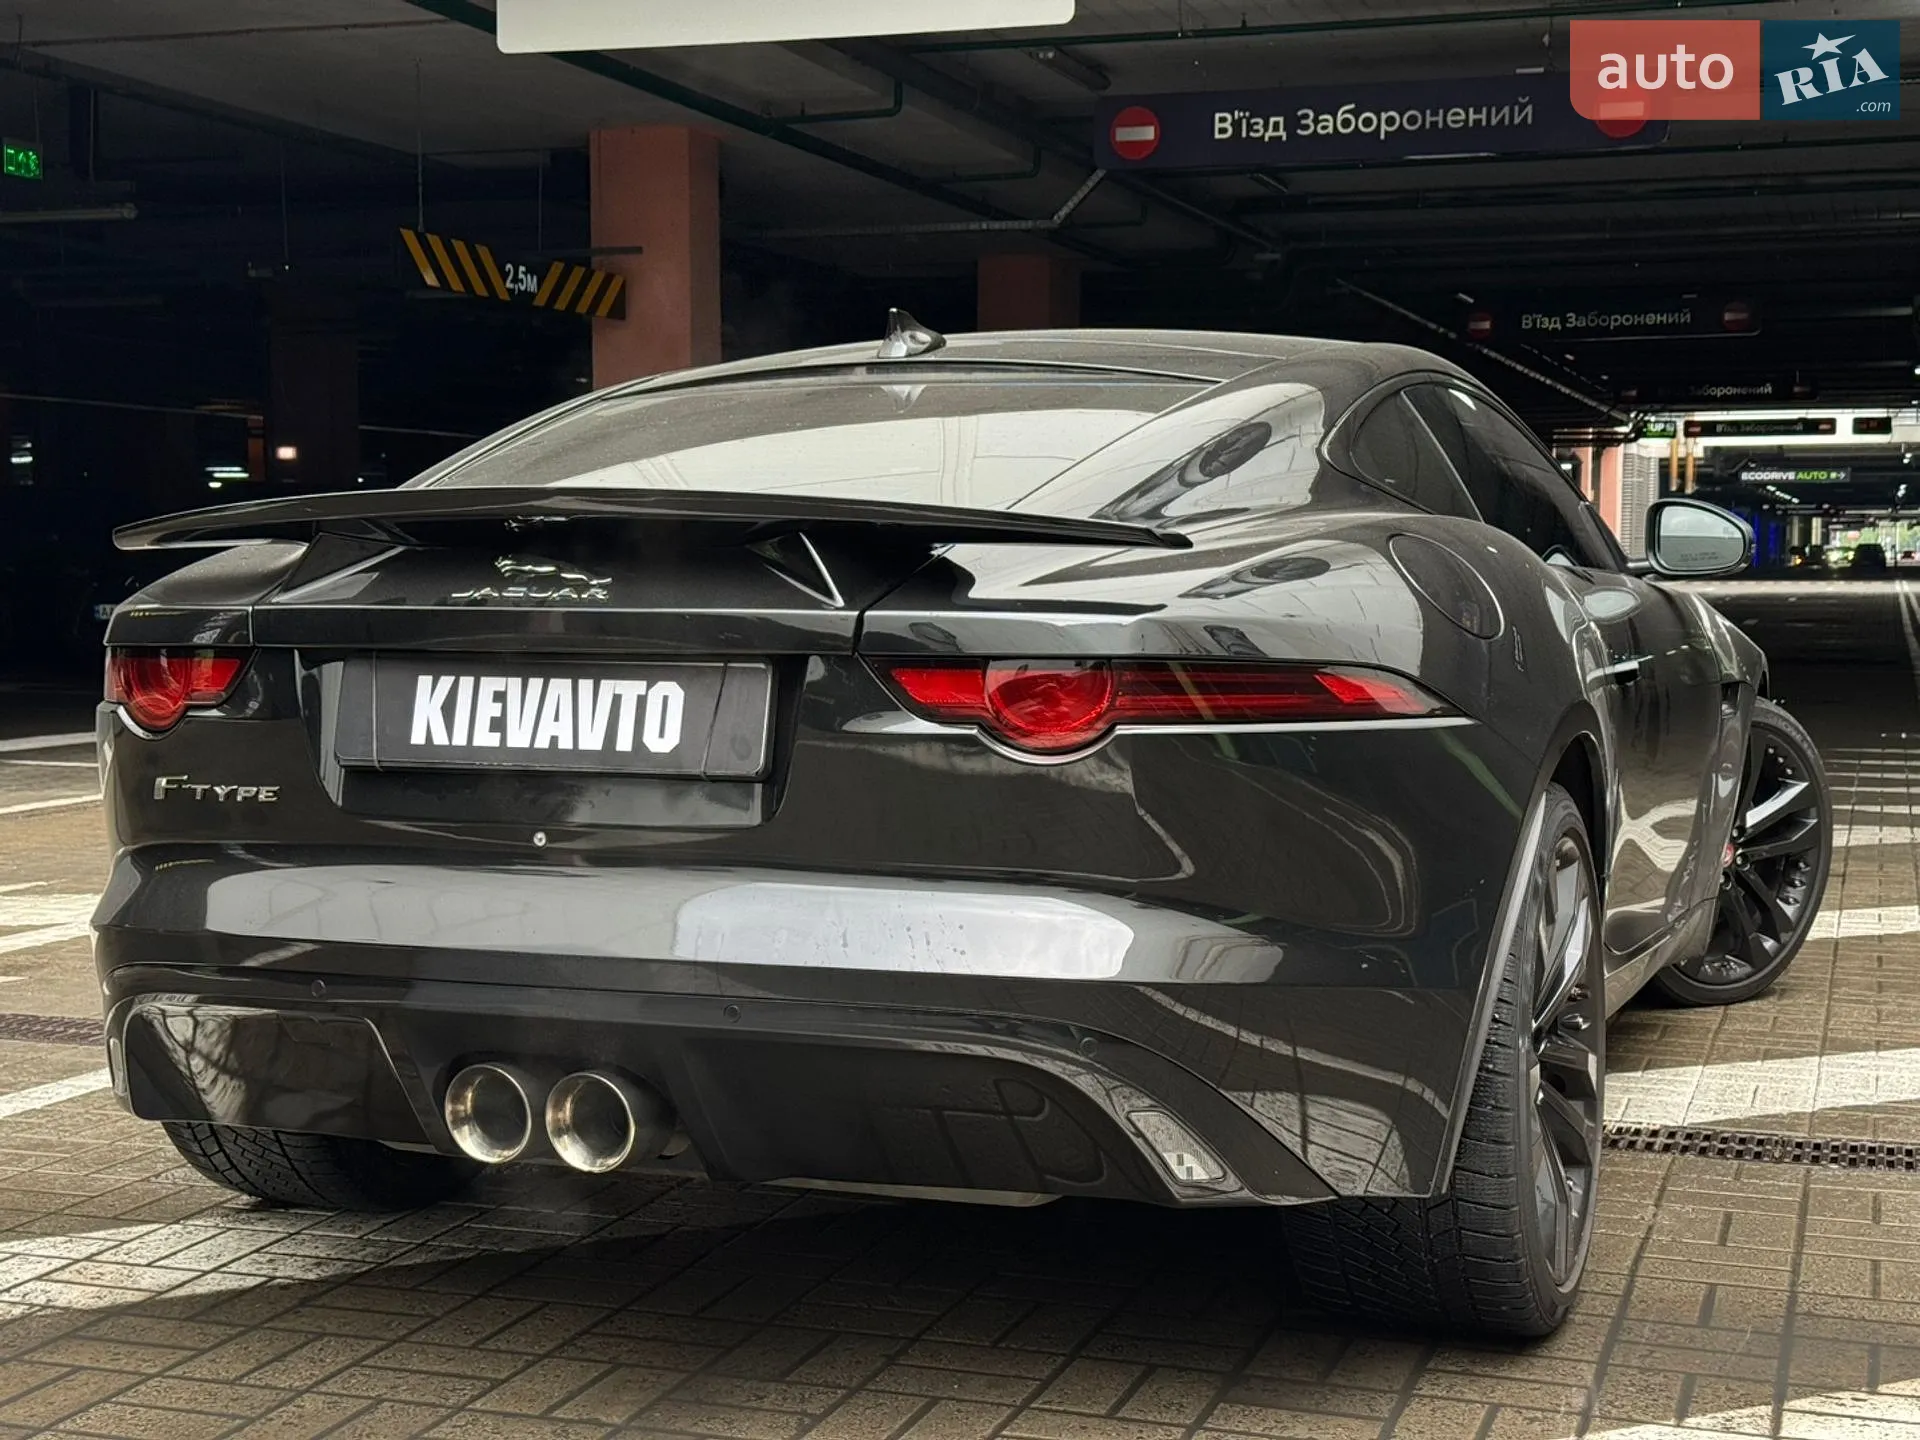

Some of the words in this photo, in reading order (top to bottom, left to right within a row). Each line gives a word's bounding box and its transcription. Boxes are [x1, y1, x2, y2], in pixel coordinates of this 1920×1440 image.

[1212, 109, 1288, 142] В'їзд
[1296, 96, 1534, 141] Заборонений
[1565, 308, 1692, 330] Заборонений
[1741, 471, 1796, 481] ECODRIVE
[1796, 471, 1828, 480] AUTO
[451, 587, 610, 601] JAGUAR
[408, 674, 686, 754] KIEVAVTO
